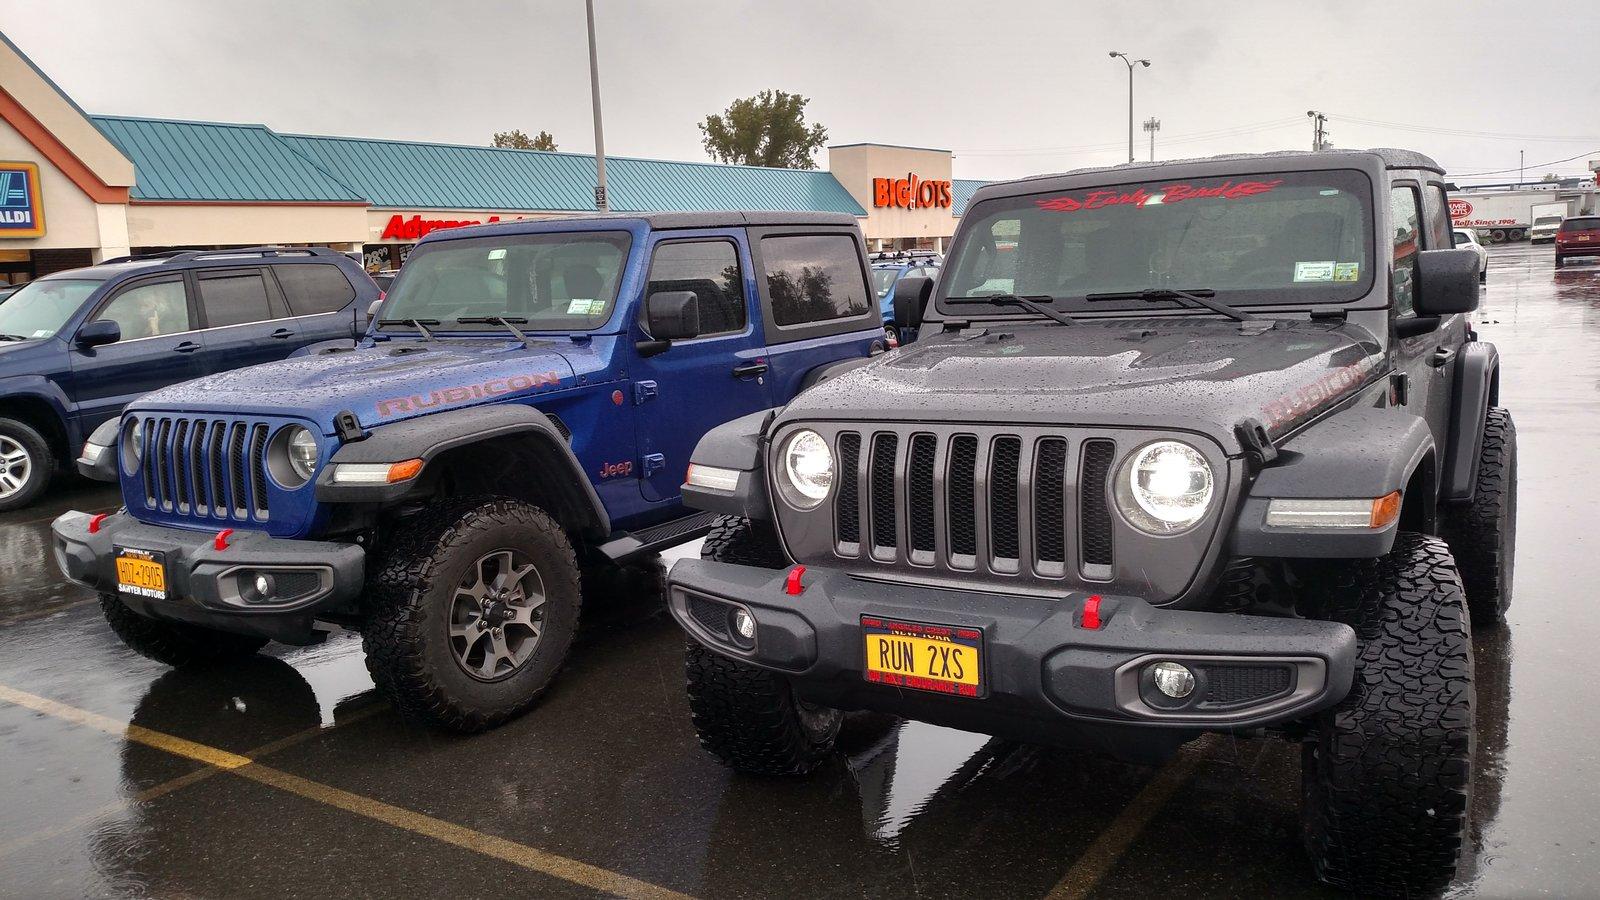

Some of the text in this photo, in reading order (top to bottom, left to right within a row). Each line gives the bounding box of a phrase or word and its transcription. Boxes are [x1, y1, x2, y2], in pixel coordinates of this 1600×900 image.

[1082, 180, 1232, 209] Early Bird
[381, 214, 481, 240] Adva
[376, 370, 561, 418] RUBICON
[599, 460, 633, 478] Jeep
[118, 584, 165, 599] SAWYER MOTORS
[879, 638, 964, 680] RUN 2XS
